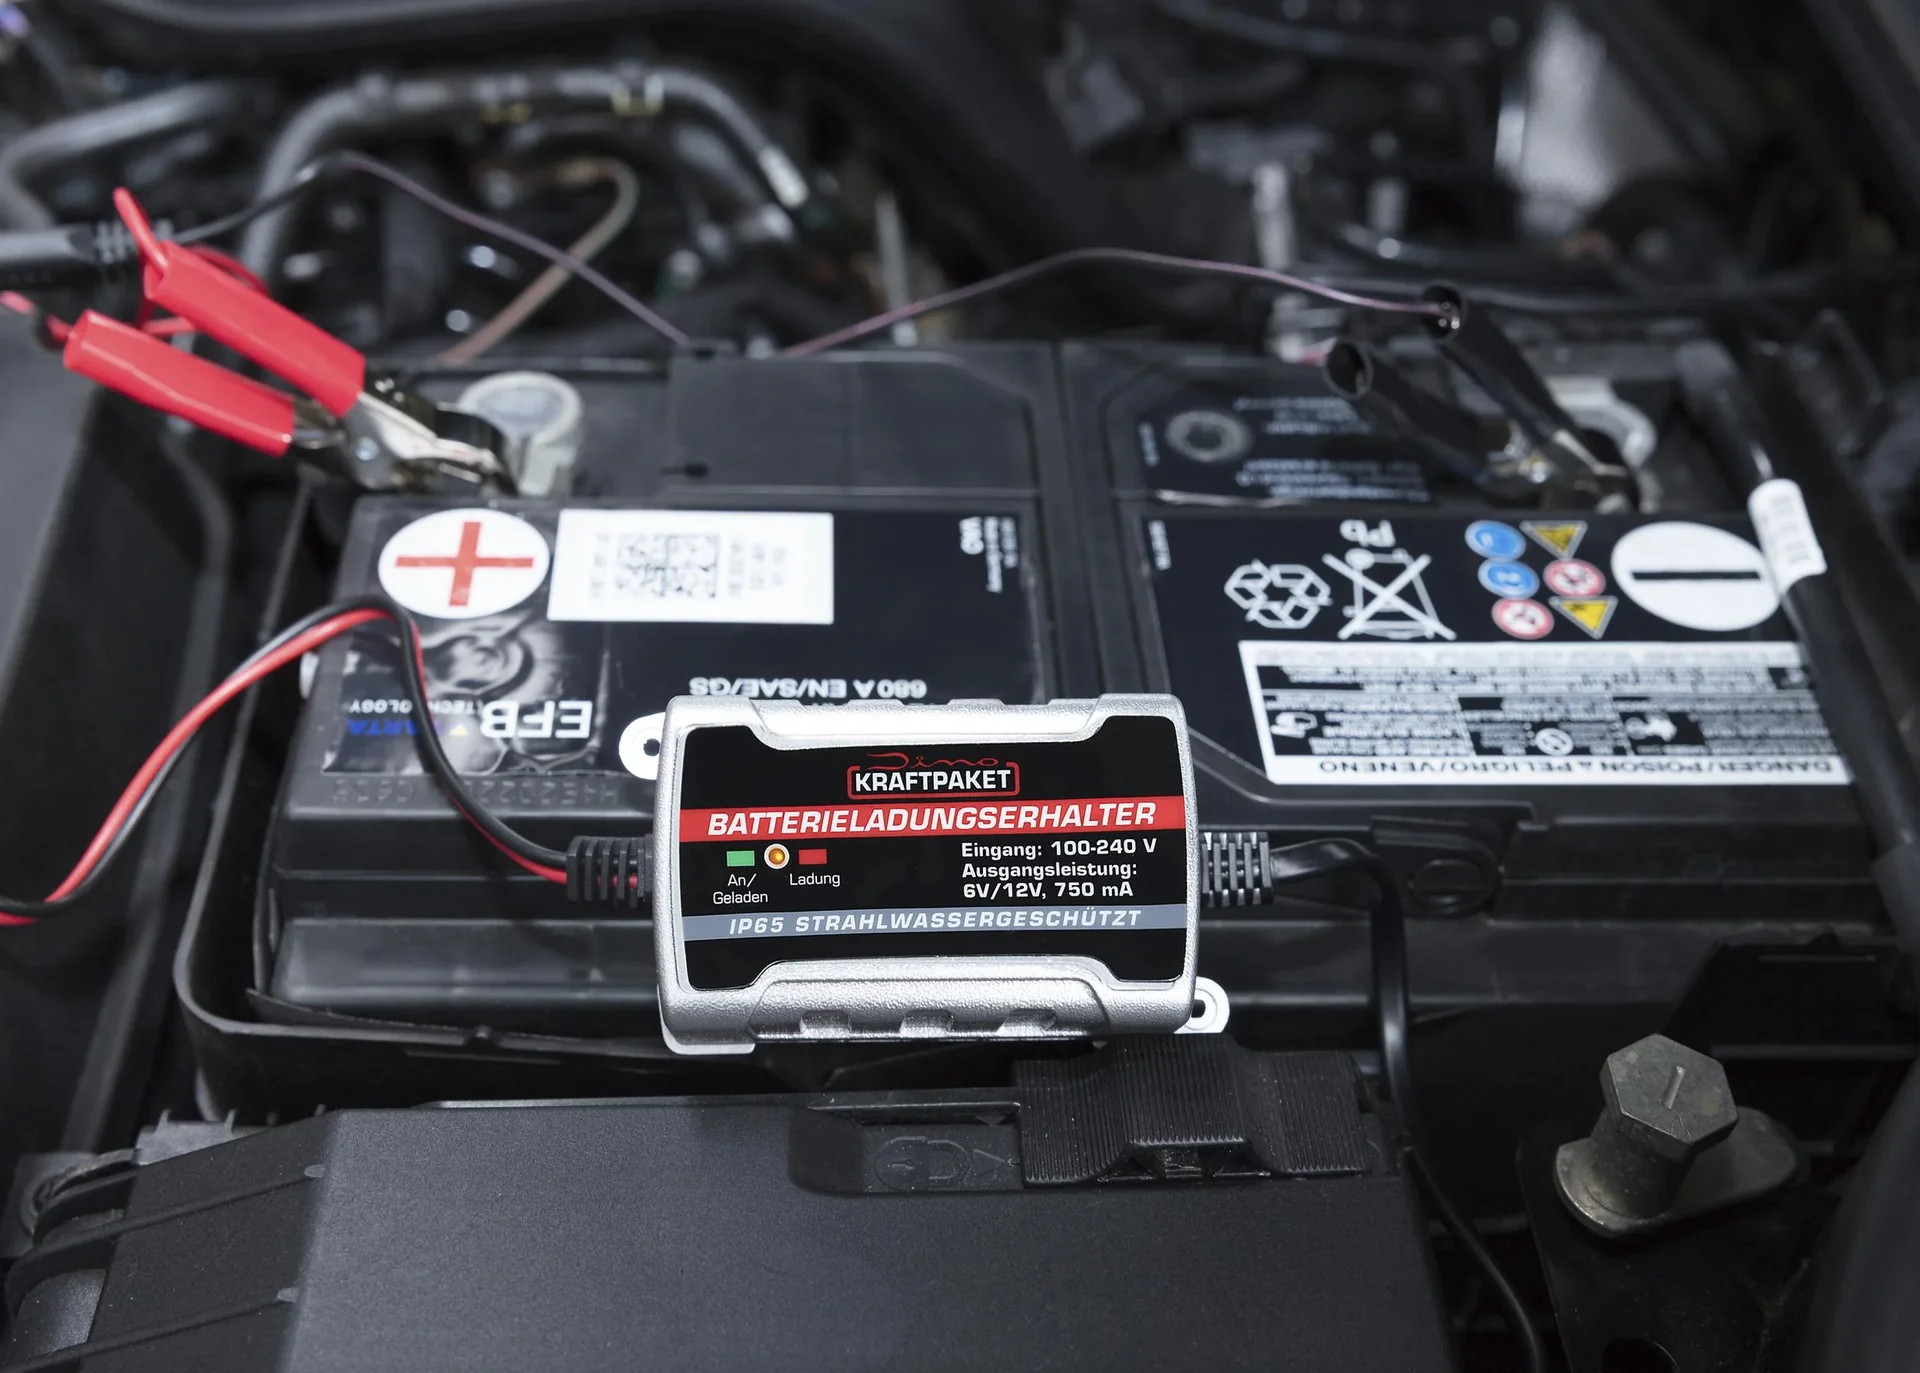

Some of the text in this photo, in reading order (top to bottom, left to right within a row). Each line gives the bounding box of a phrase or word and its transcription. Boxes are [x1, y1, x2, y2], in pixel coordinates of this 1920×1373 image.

[1339, 519, 1396, 547] Pb
[688, 677, 928, 699] 680 A EN/SAE/GS
[348, 699, 476, 715] TECHOLOGY
[480, 700, 593, 739] EFB
[855, 769, 1011, 792] KRAFTPAKET
[707, 802, 1157, 836] BATTERIELADUNGSERHALTER
[961, 838, 1158, 861] Eingang: 100-240 V
[727, 873, 757, 888] An/
[789, 872, 841, 888] Ladung
[961, 862, 1138, 881] Ausgangsleistung:
[712, 890, 769, 905] Geladen
[963, 881, 1134, 900] 6V/12V, 750 mA
[729, 906, 1142, 935] IP65 STRAHLWASSERGESCHÜTZT
